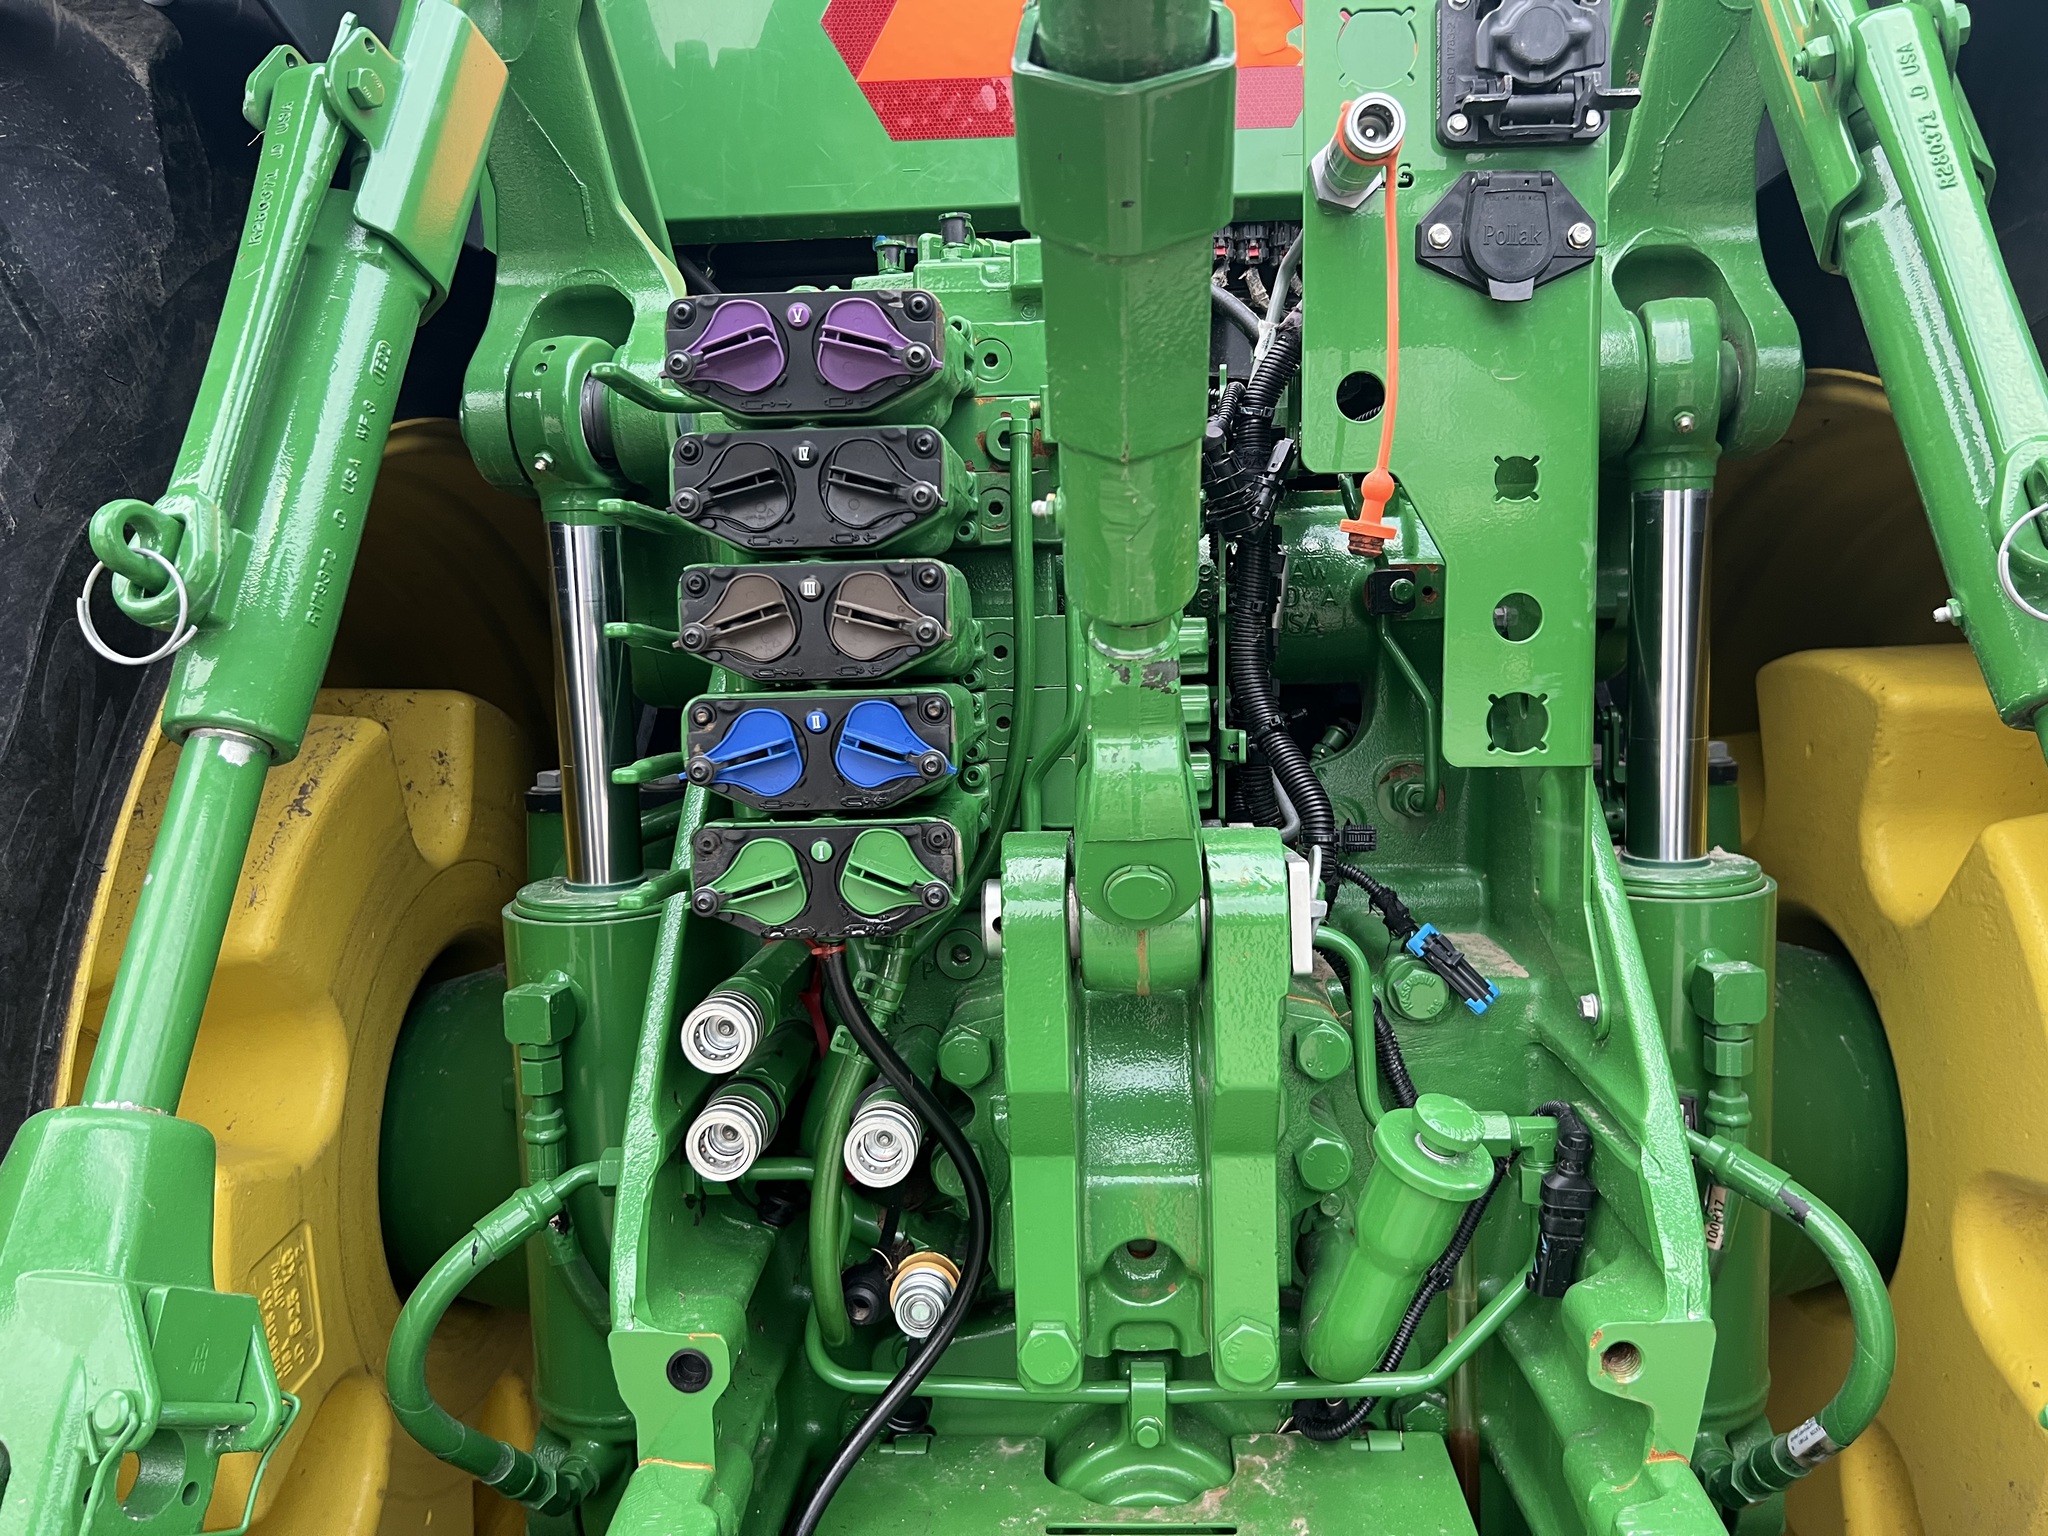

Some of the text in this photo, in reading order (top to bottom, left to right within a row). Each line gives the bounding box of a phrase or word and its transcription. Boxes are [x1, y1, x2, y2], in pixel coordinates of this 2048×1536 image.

[1447, 22, 1456, 85] ISO 11783-2
[1896, 42, 1921, 77] USA
[275, 101, 294, 136] USA
[1918, 110, 1959, 190] R280371
[1483, 223, 1543, 246] Pollak
[792, 308, 803, 323] V
[798, 446, 810, 461] IV
[341, 458, 362, 496] USA
[803, 581, 817, 596] III
[811, 715, 822, 730] II
[818, 845, 825, 860] I
